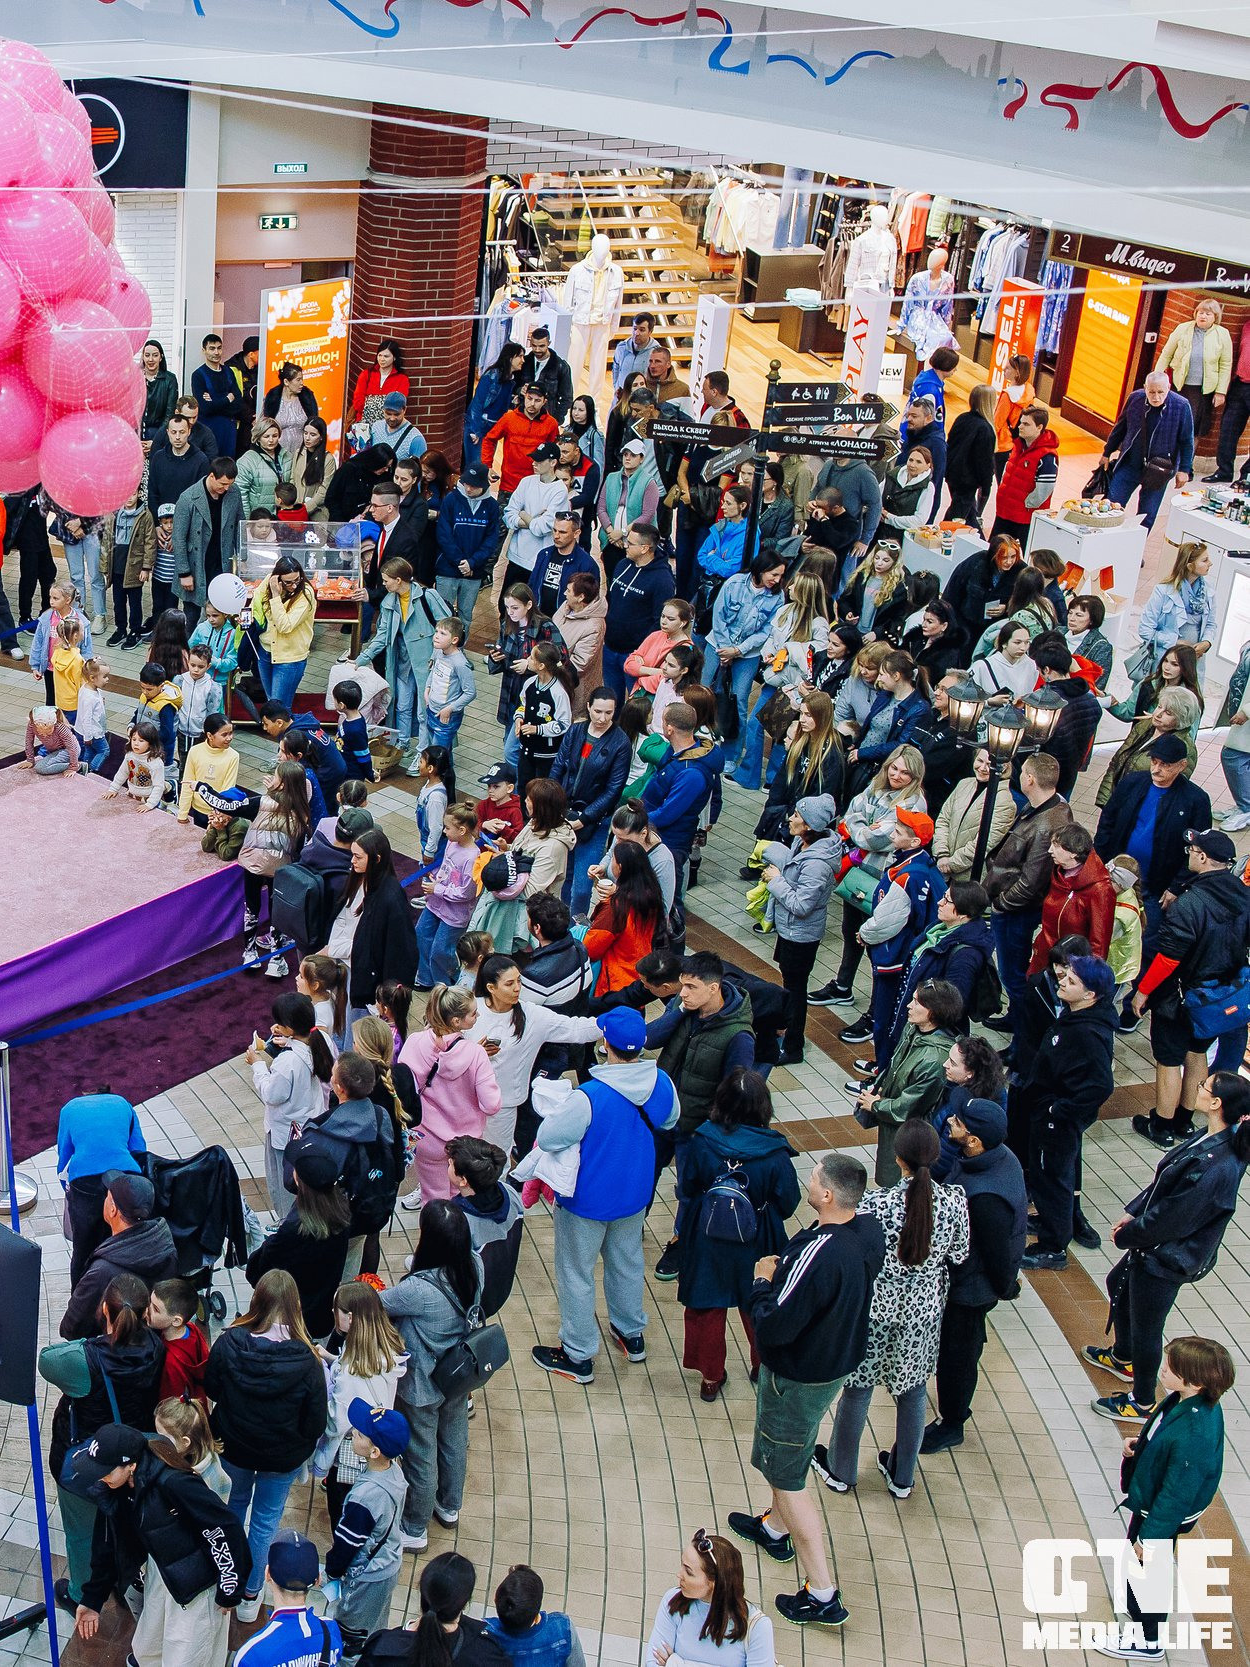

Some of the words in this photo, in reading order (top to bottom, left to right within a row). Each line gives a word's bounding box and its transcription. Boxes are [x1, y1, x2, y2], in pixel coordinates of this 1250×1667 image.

[276, 164, 305, 173] ВЫХОД
[1061, 234, 1071, 249] 2
[1014, 299, 1026, 337] LIVING
[833, 407, 853, 422] Bon
[855, 407, 876, 421] Ville
[653, 423, 678, 432] ВЫХОД
[685, 426, 712, 435] СКВЕРУ
[830, 440, 878, 450] «ЛОНДОН»
